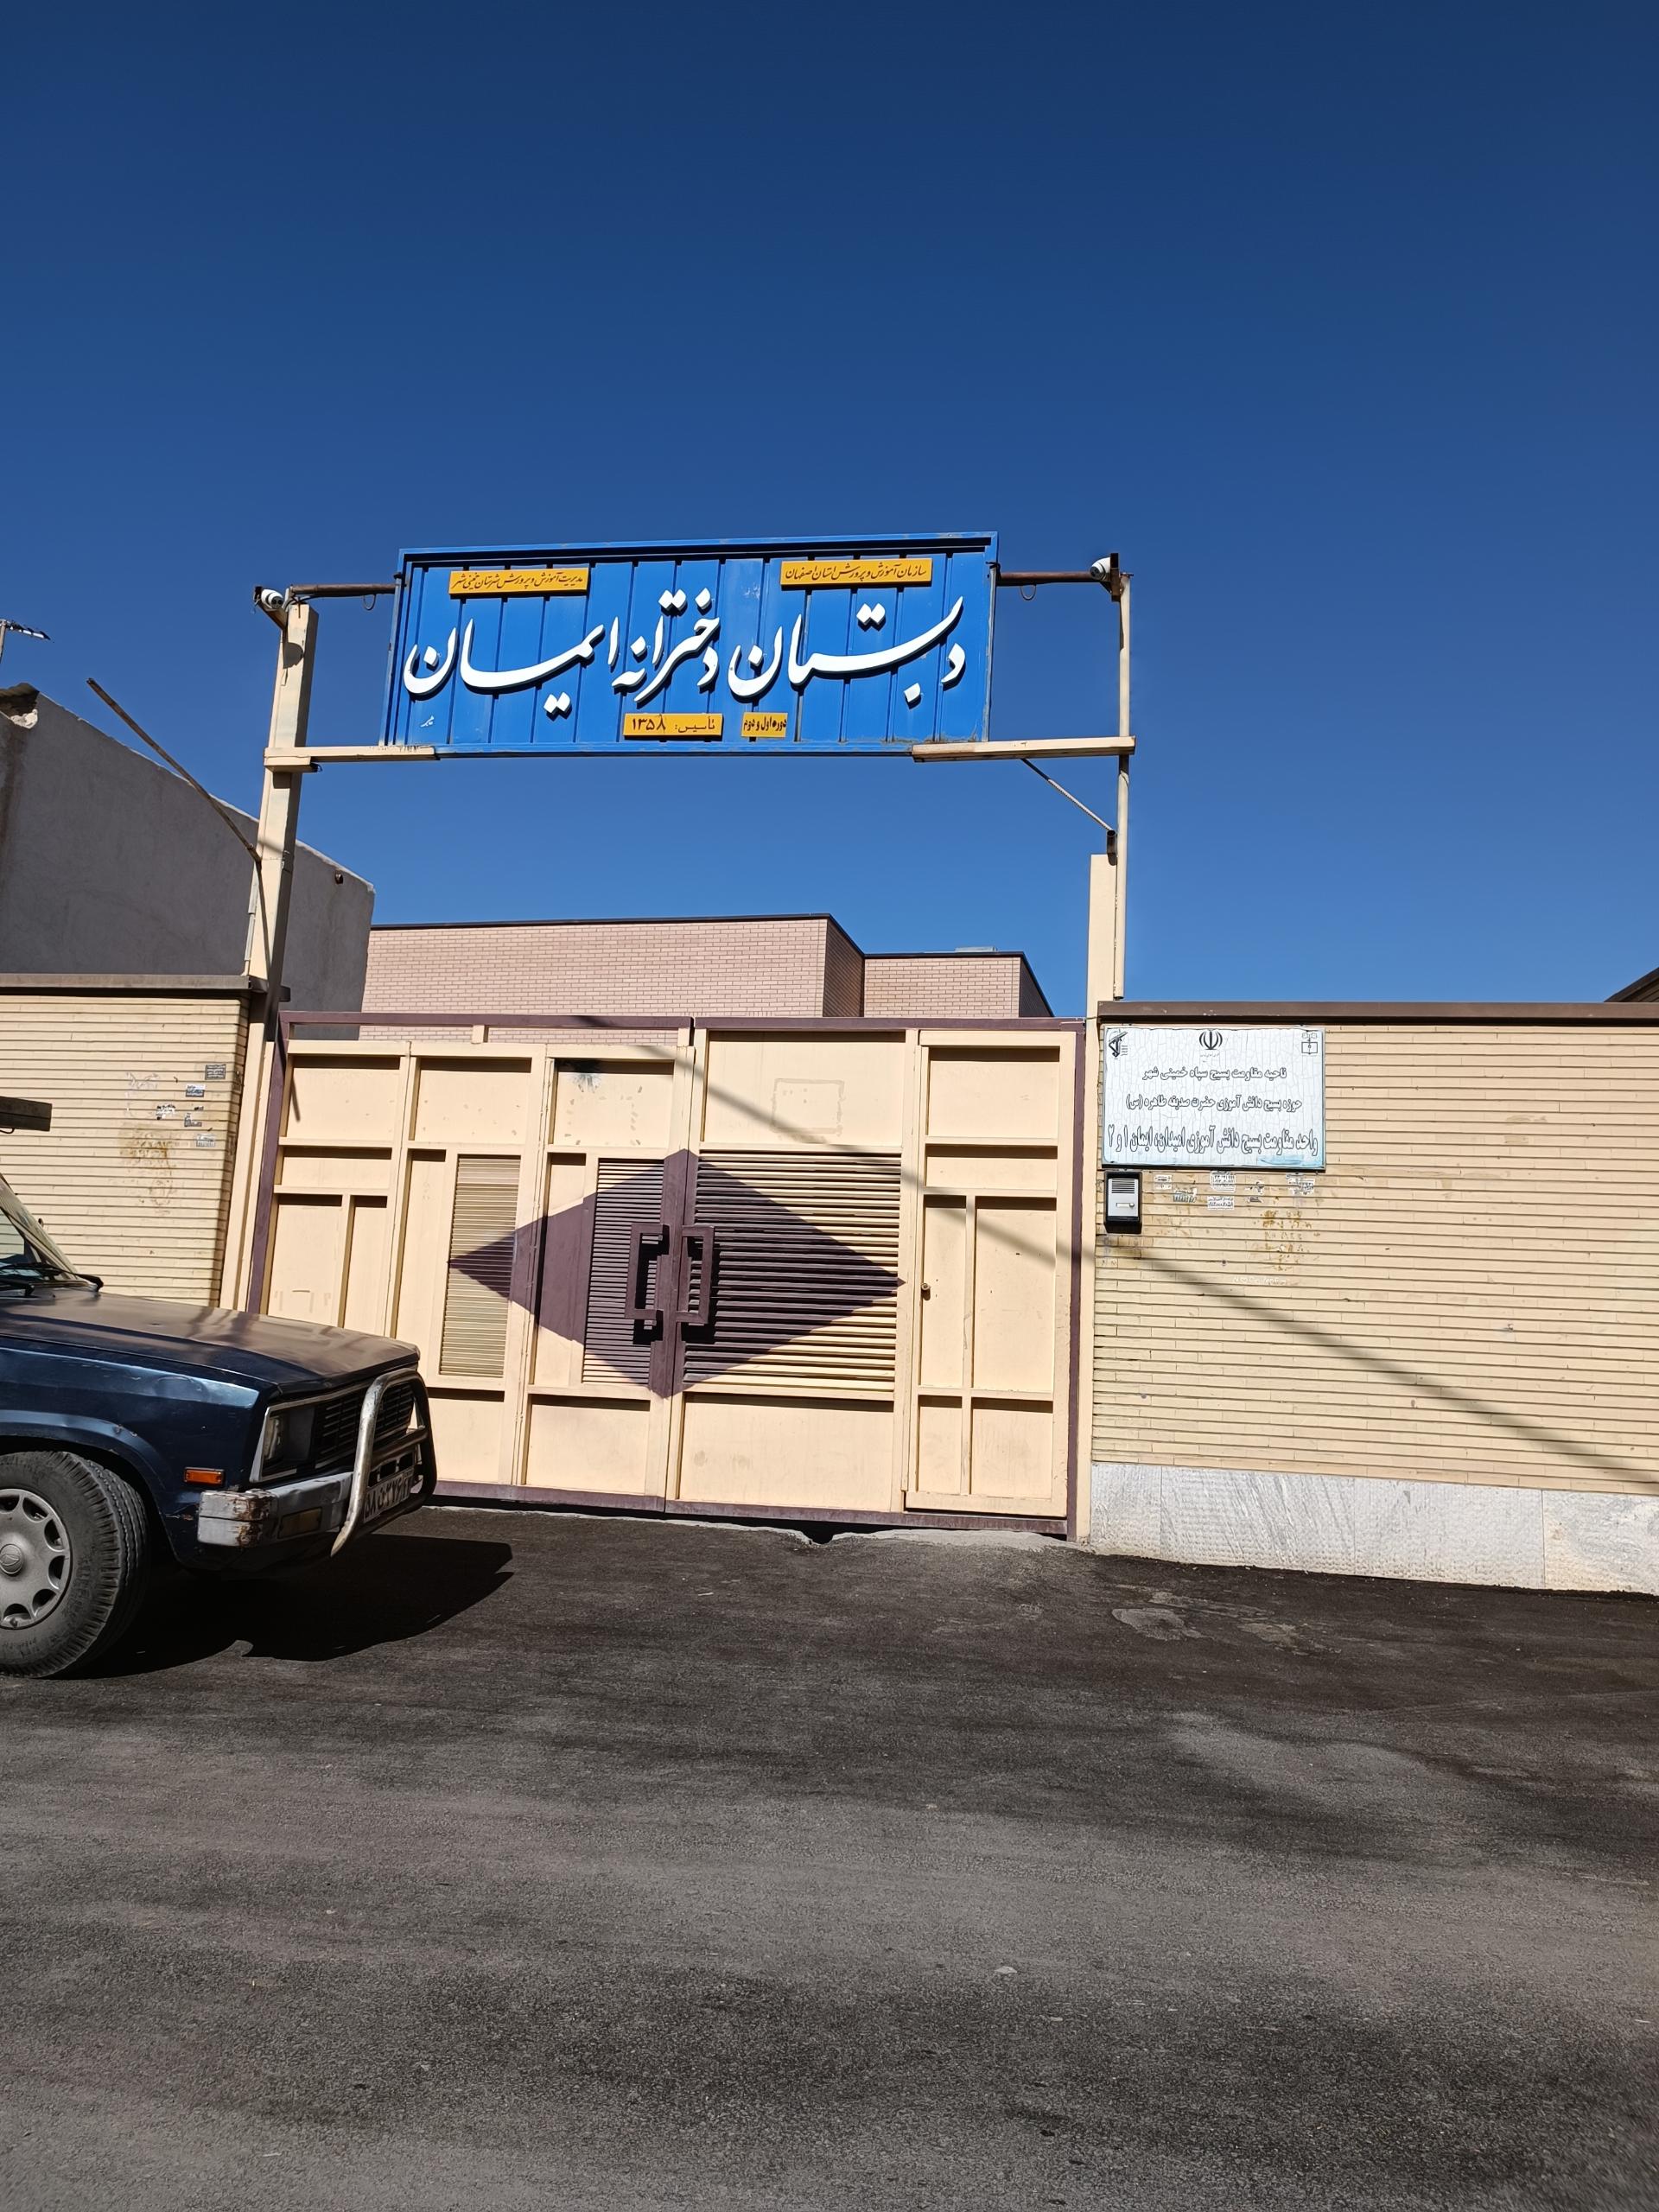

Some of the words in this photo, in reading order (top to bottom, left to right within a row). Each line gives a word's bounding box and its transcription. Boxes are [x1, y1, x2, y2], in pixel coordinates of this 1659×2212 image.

[785, 565, 817, 581] اصفهان
[812, 566, 837, 582] استان
[831, 563, 868, 582] پرورش
[871, 562, 903, 580] آموزش
[897, 563, 927, 578] سازمان
[450, 572, 467, 590] شهر
[474, 572, 500, 590] شهرستان
[497, 573, 531, 590] پرورش
[534, 571, 563, 588] آموزش
[559, 573, 583, 588] مدیریت
[611, 588, 720, 702] دخترانه
[728, 596, 966, 702] دبستان
[403, 617, 620, 714] ایمان
[632, 716, 666, 732] ۱۳۵۸
[743, 718, 755, 732] دوم
[760, 715, 772, 732] اول
[772, 718, 787, 732] دوره
[1141, 1065, 1160, 1081] شهر
[1160, 1065, 1189, 1081] خمینی
[1189, 1065, 1209, 1081] سپاه
[1210, 1067, 1230, 1081] بسیج
[1231, 1066, 1263, 1081] مقاومت
[1264, 1067, 1287, 1081] ناحیه
[1126, 1093, 1143, 1110] (س)
[1143, 1094, 1167, 1111] طاهره
[1167, 1095, 1190, 1110] صدیقه
[1192, 1095, 1217, 1111] حضرت
[1216, 1094, 1243, 1112] آموزی
[1242, 1095, 1262, 1112] دانش
[1263, 1098, 1282, 1112] بسیج
[1282, 1098, 1303, 1113] حوزه
[1108, 1123, 1115, 1147] ۲
[1116, 1134, 1122, 1153] و
[1123, 1124, 1128, 1147] ۱
[1129, 1124, 1154, 1153] ایمان
[1185, 1124, 1217, 1154] آموزی
[1217, 1127, 1240, 1154] دانش
[1240, 1133, 1262, 1154] بسیج
[1262, 1128, 1294, 1156] مقاومت
[1295, 1128, 1319, 1157] واحد
